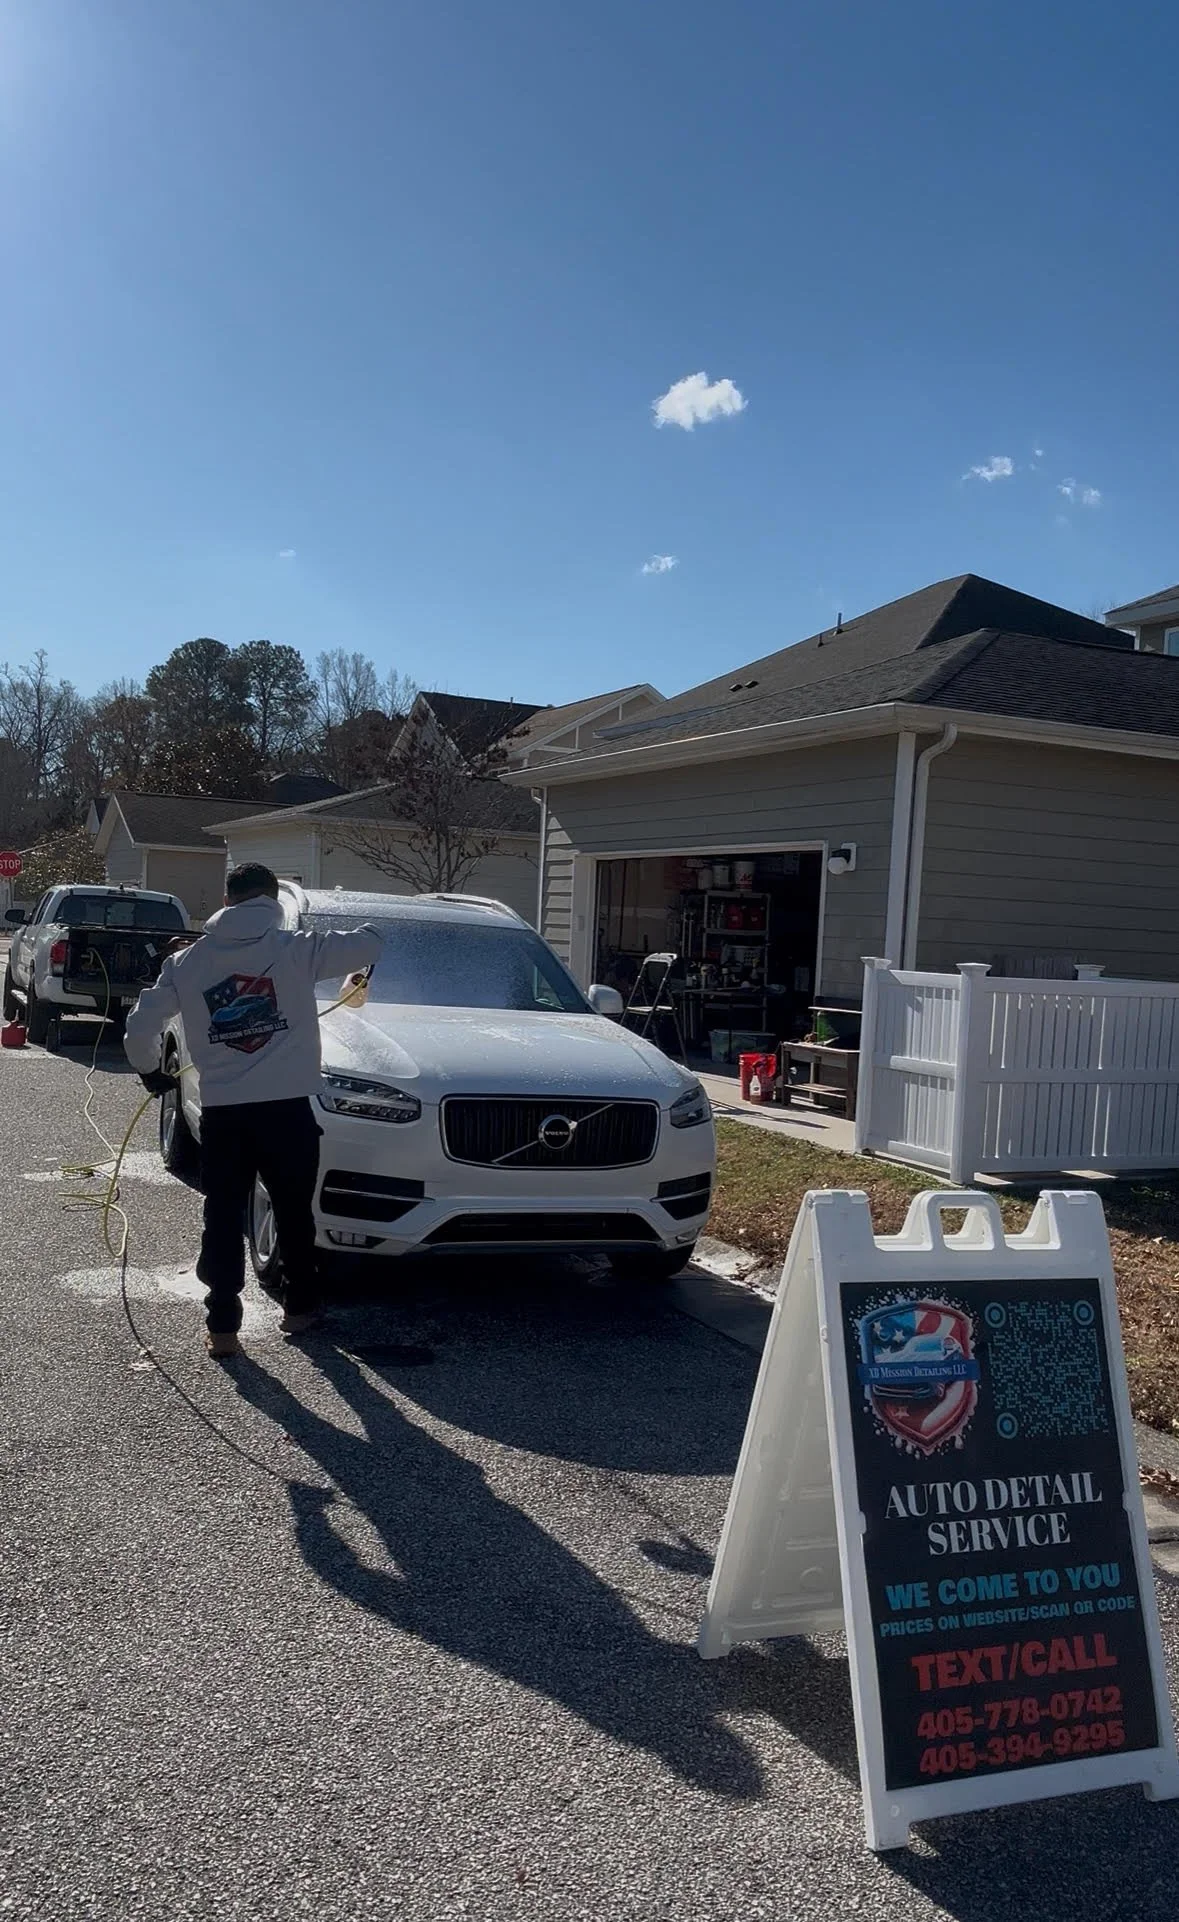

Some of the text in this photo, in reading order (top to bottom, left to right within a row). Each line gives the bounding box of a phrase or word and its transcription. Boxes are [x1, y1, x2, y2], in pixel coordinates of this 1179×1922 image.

[274, 1021, 286, 1030] LLC
[952, 1364, 967, 1375] LLC
[885, 1472, 1102, 1519] AUTO DETAIL
[928, 1513, 1071, 1556] SERVICE
[886, 1563, 1120, 1611] WE COME TO YOU
[880, 1619, 934, 1637] PRICES
[938, 1614, 960, 1629] ON
[962, 1602, 1070, 1628] WEBSITE/SCAN
[1097, 1595, 1136, 1611] CODE
[911, 1634, 1118, 1691] TEXT/CALL
[917, 1686, 1123, 1740] 405-778-0742
[920, 1720, 1125, 1775] 405-394-9295
